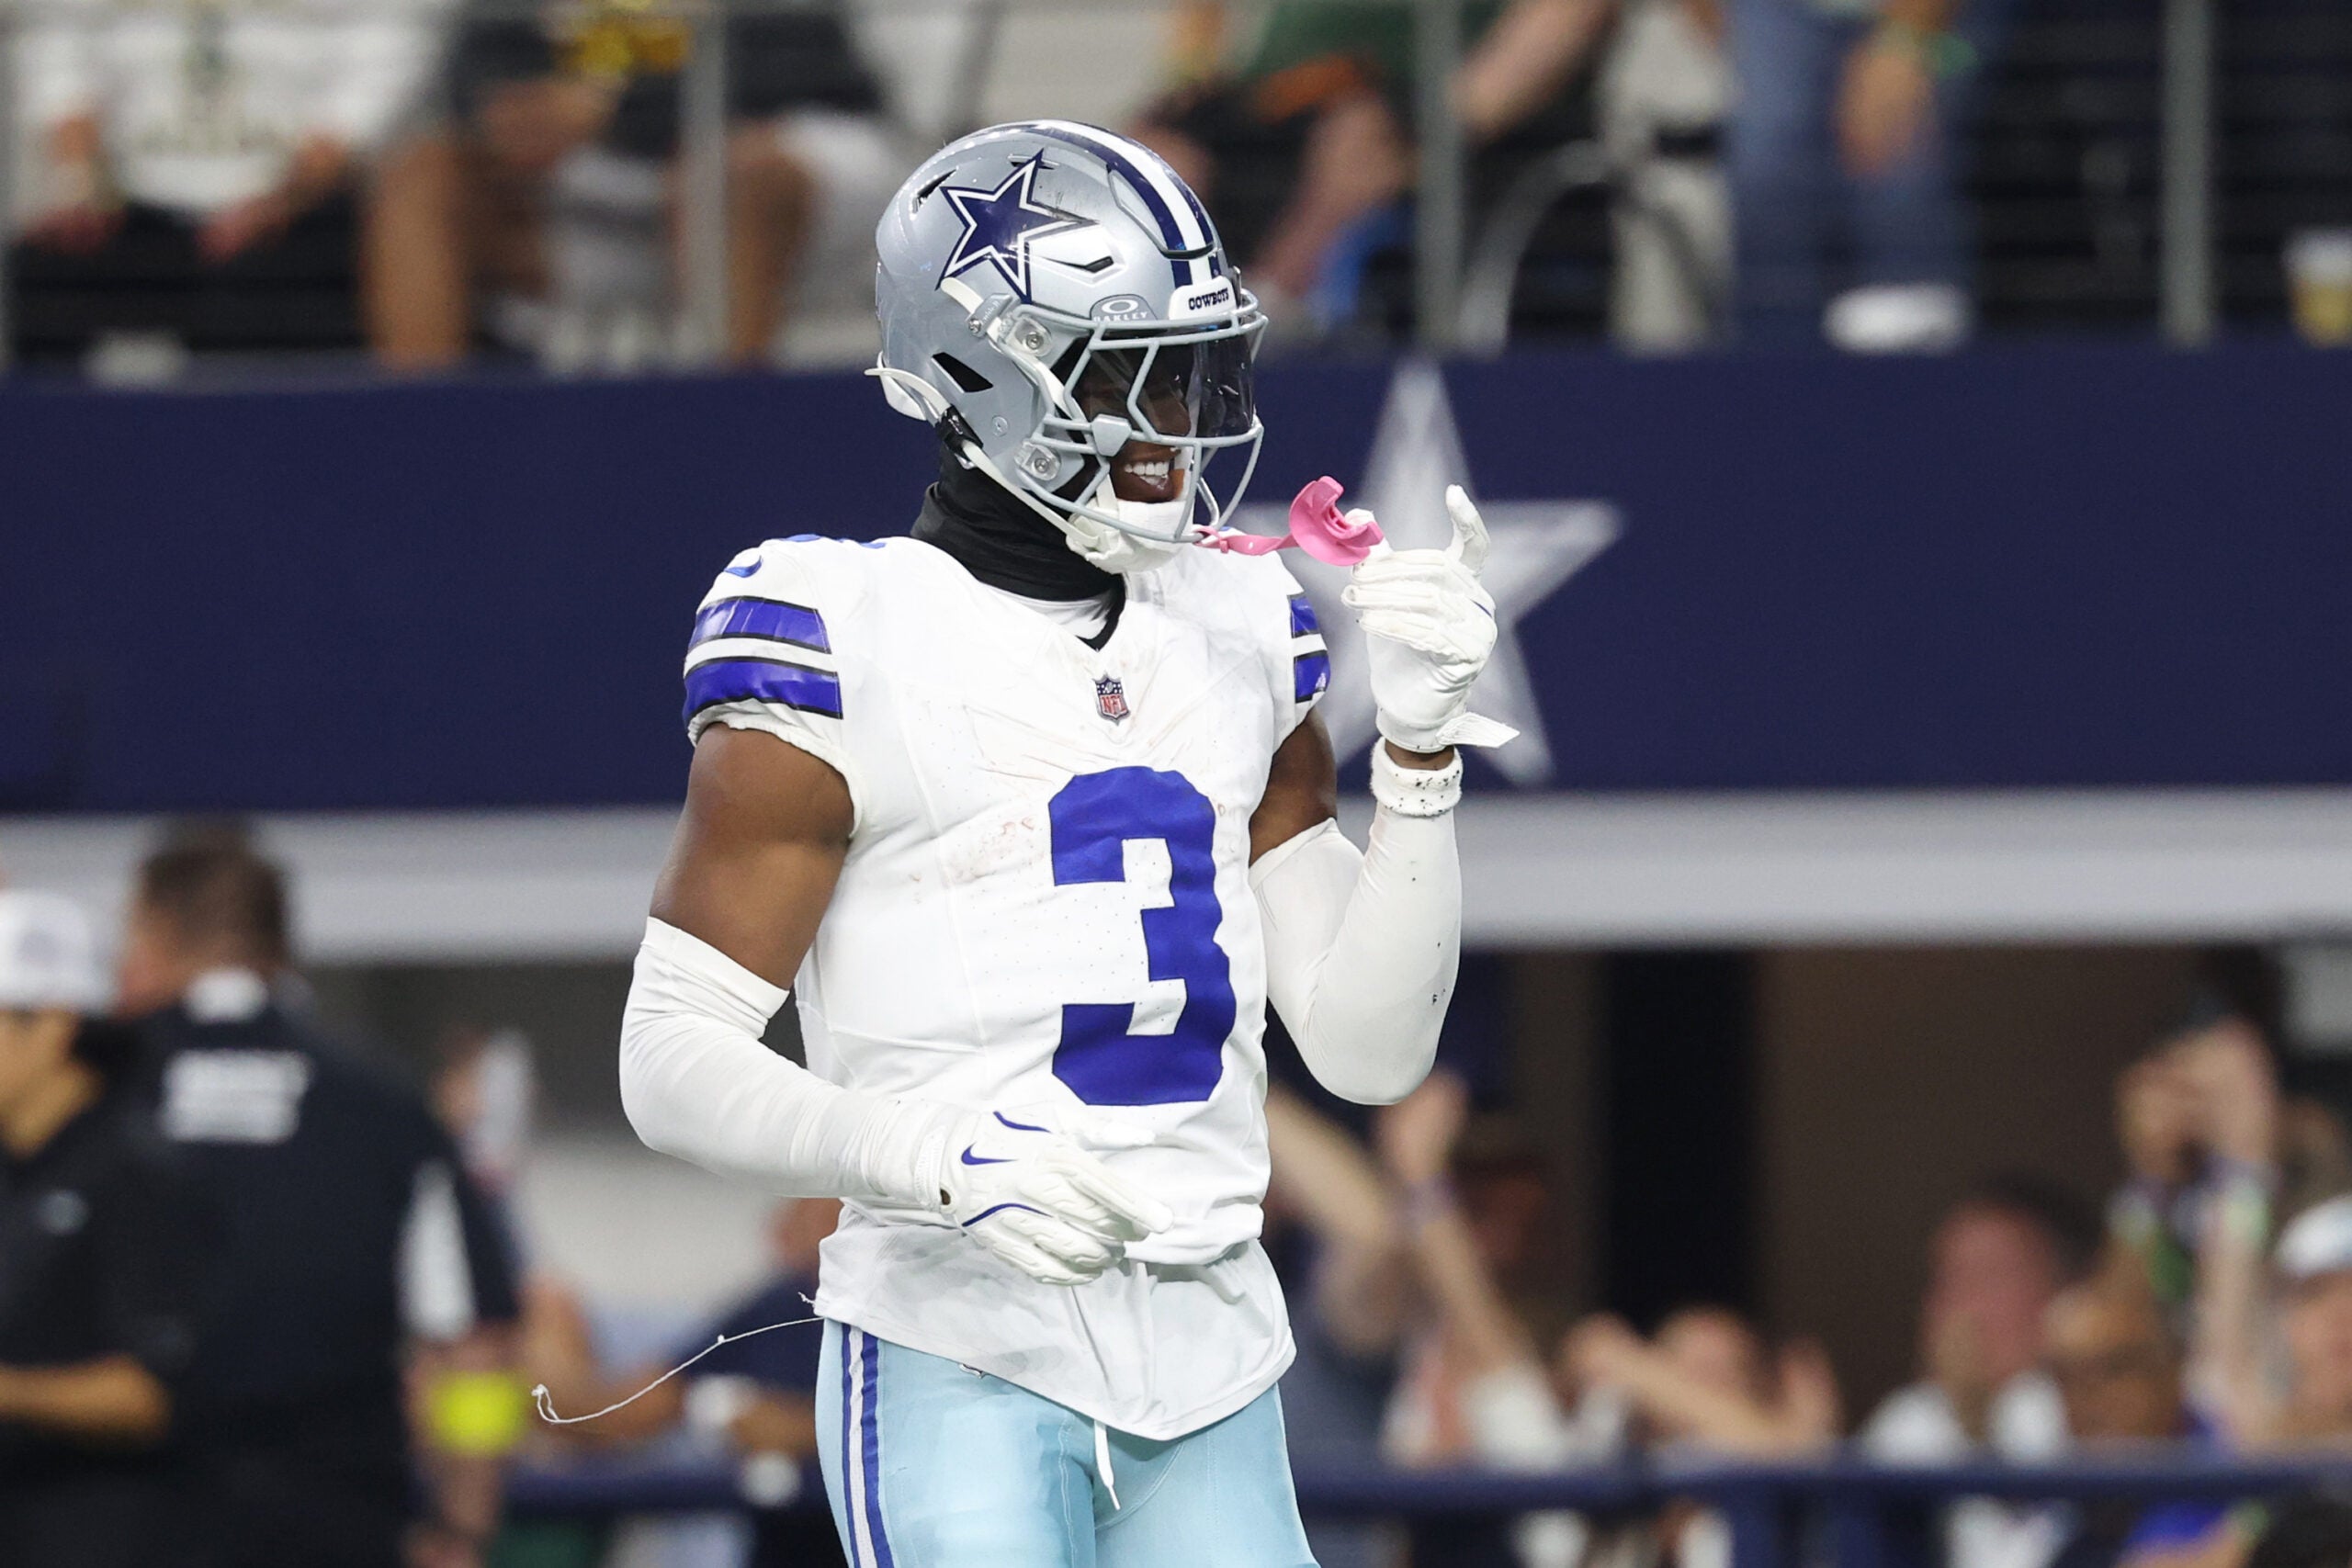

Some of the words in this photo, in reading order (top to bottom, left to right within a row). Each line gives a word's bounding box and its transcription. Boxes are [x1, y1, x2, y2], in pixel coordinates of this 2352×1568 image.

[1188, 288, 1229, 310] COWBOYS
[1102, 694, 1126, 715] NFL
[1048, 766, 1237, 1106] 3
